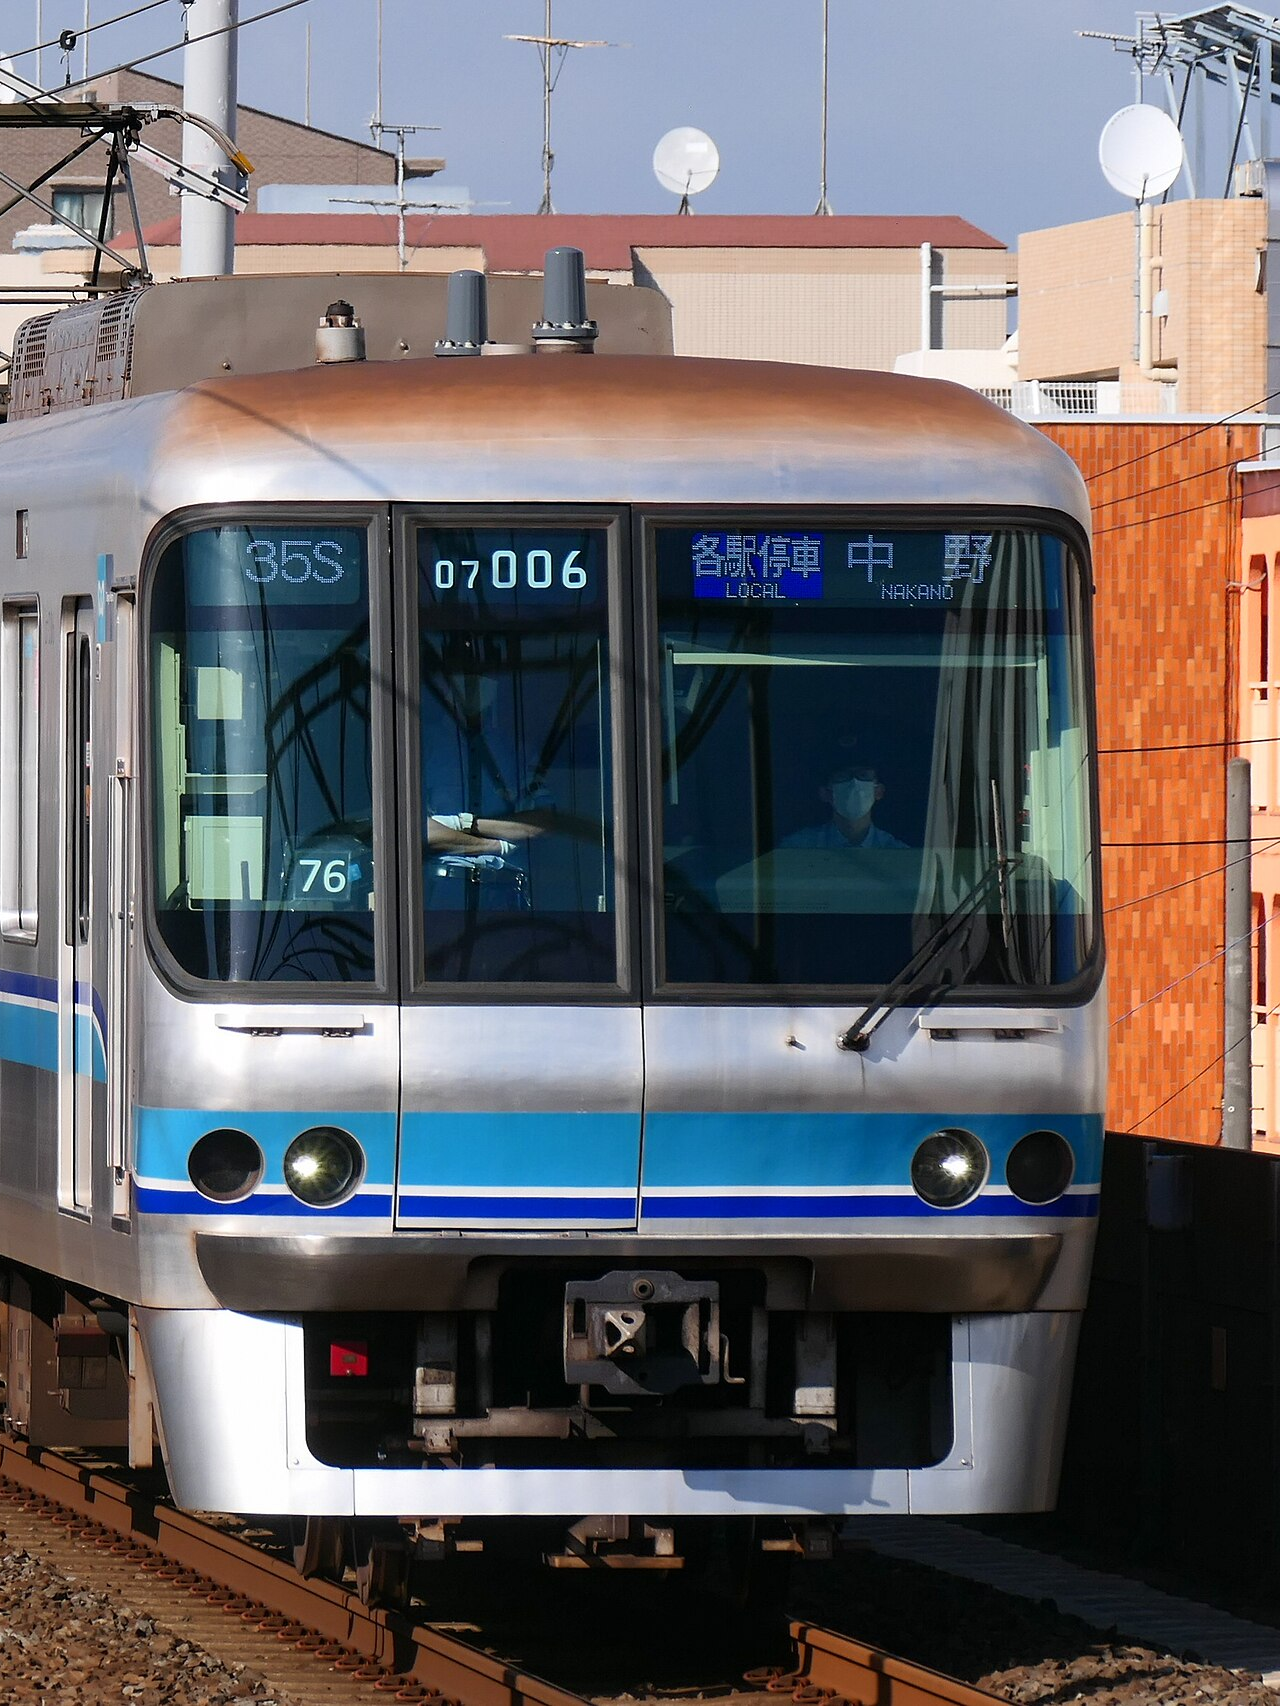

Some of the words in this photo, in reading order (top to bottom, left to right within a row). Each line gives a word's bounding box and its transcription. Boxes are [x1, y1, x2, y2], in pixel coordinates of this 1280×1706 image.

[245, 540, 345, 584] 35S
[692, 534, 821, 578] 各駅停車
[847, 534, 993, 584] 中野
[725, 583, 787, 599] LOCAL
[881, 584, 954, 600] NAKANO
[299, 859, 346, 894] 76
